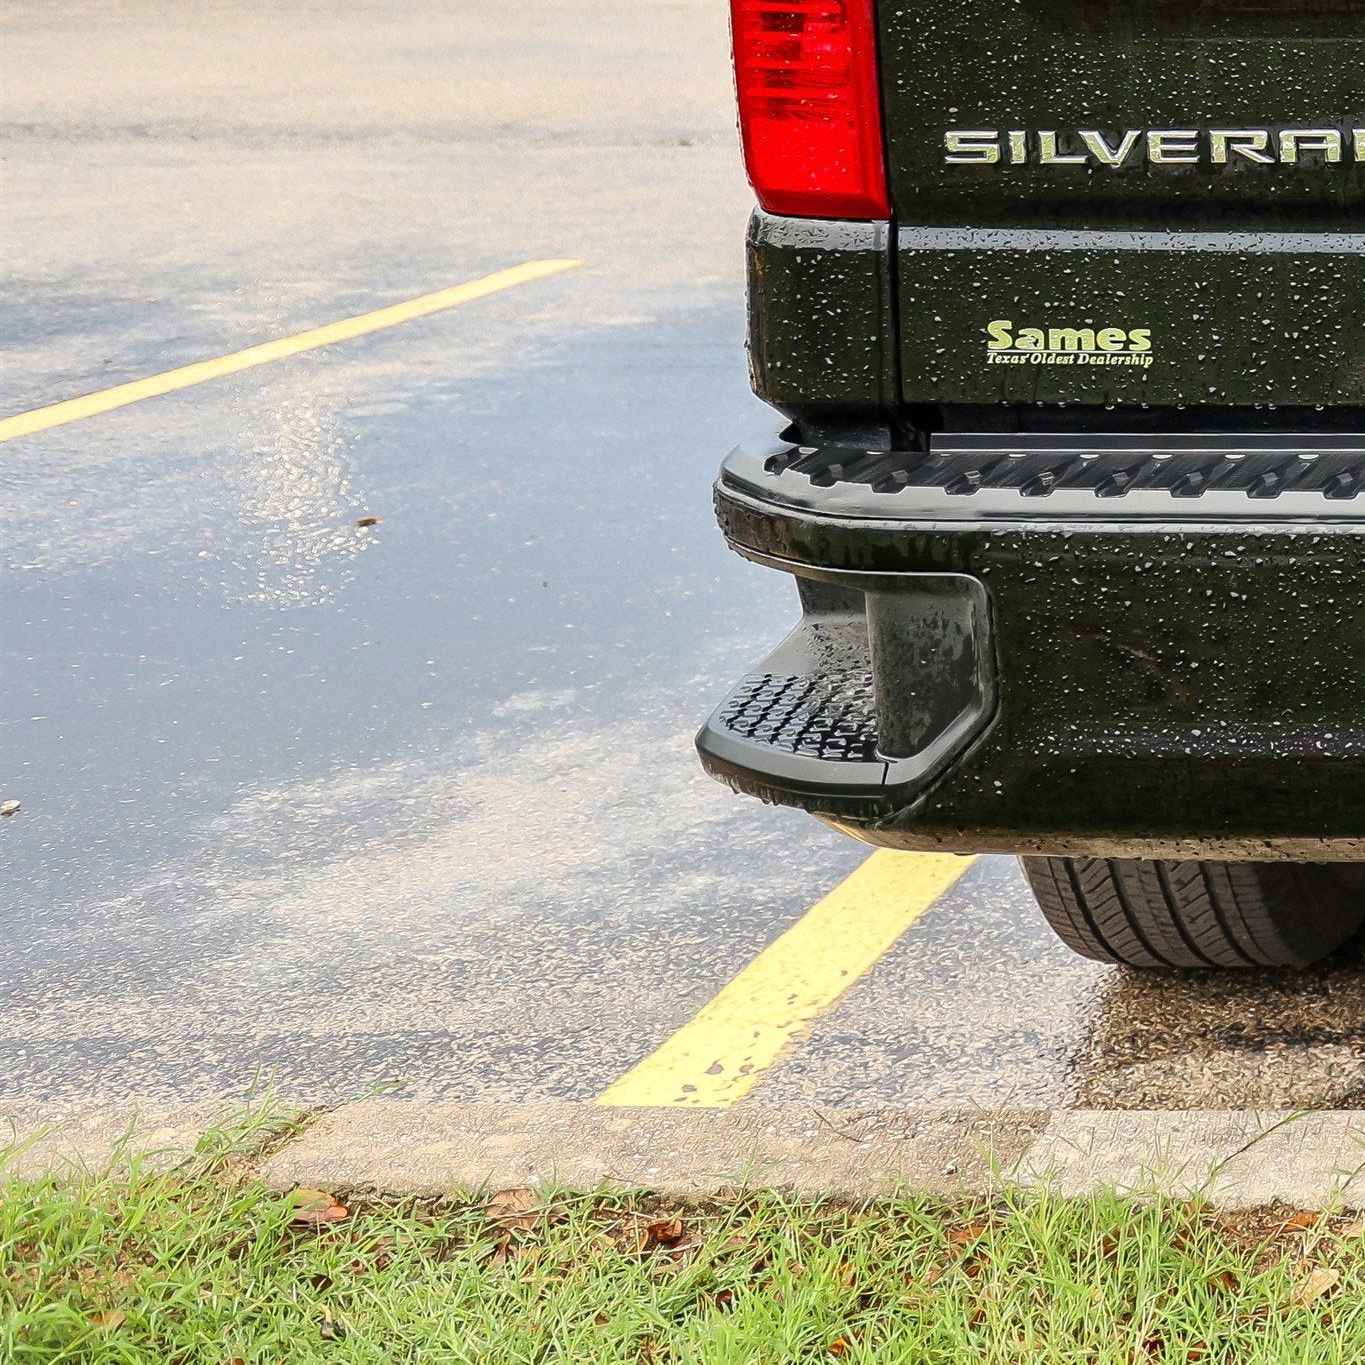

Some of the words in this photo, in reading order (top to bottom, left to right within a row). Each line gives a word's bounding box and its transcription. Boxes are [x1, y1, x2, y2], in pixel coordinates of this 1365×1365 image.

[987, 320, 1152, 350] Sames
[1030, 353, 1075, 365] Oldest
[1077, 353, 1154, 369] Dealership
